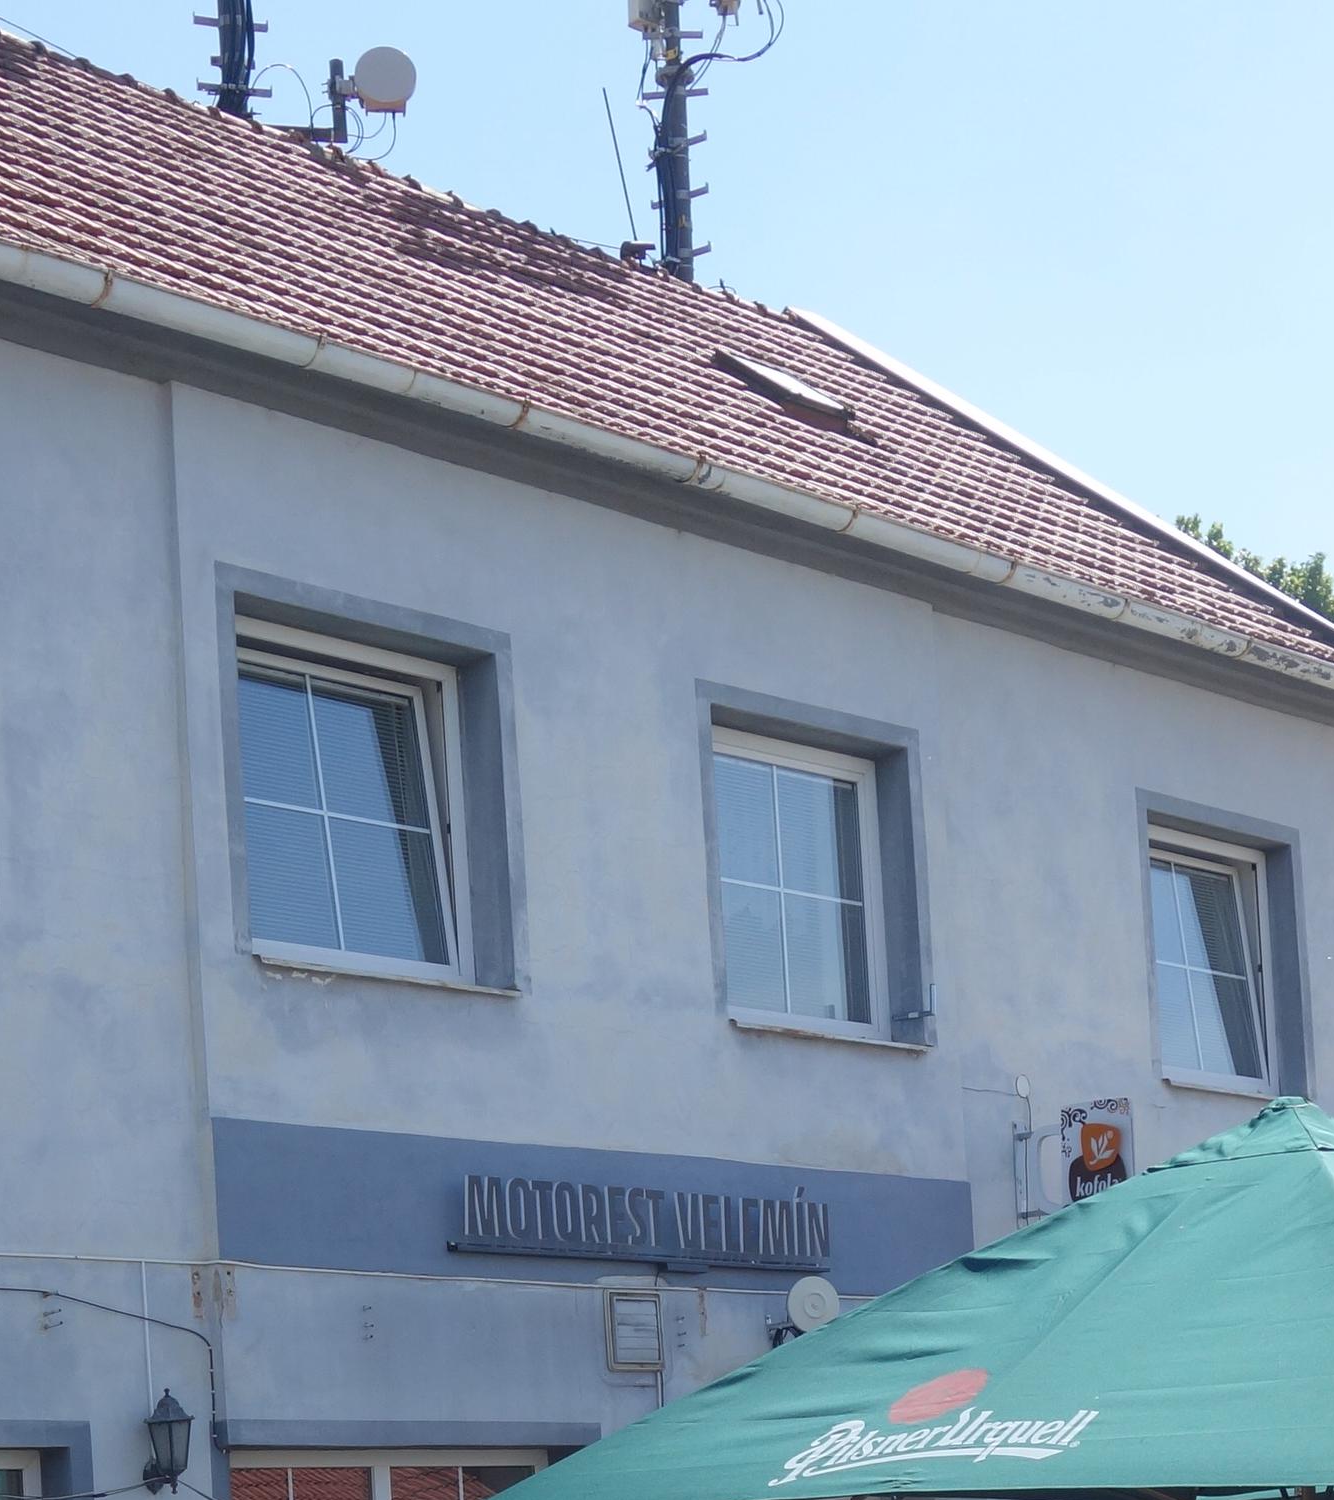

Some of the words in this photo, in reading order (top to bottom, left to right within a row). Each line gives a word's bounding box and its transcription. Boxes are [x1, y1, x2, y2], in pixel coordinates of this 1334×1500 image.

[464, 1174, 666, 1248] MOTOREST
[673, 1186, 831, 1258] VELEMÍN
[768, 1420, 952, 1487] Pilsner
[931, 1407, 1100, 1463] Urquell
